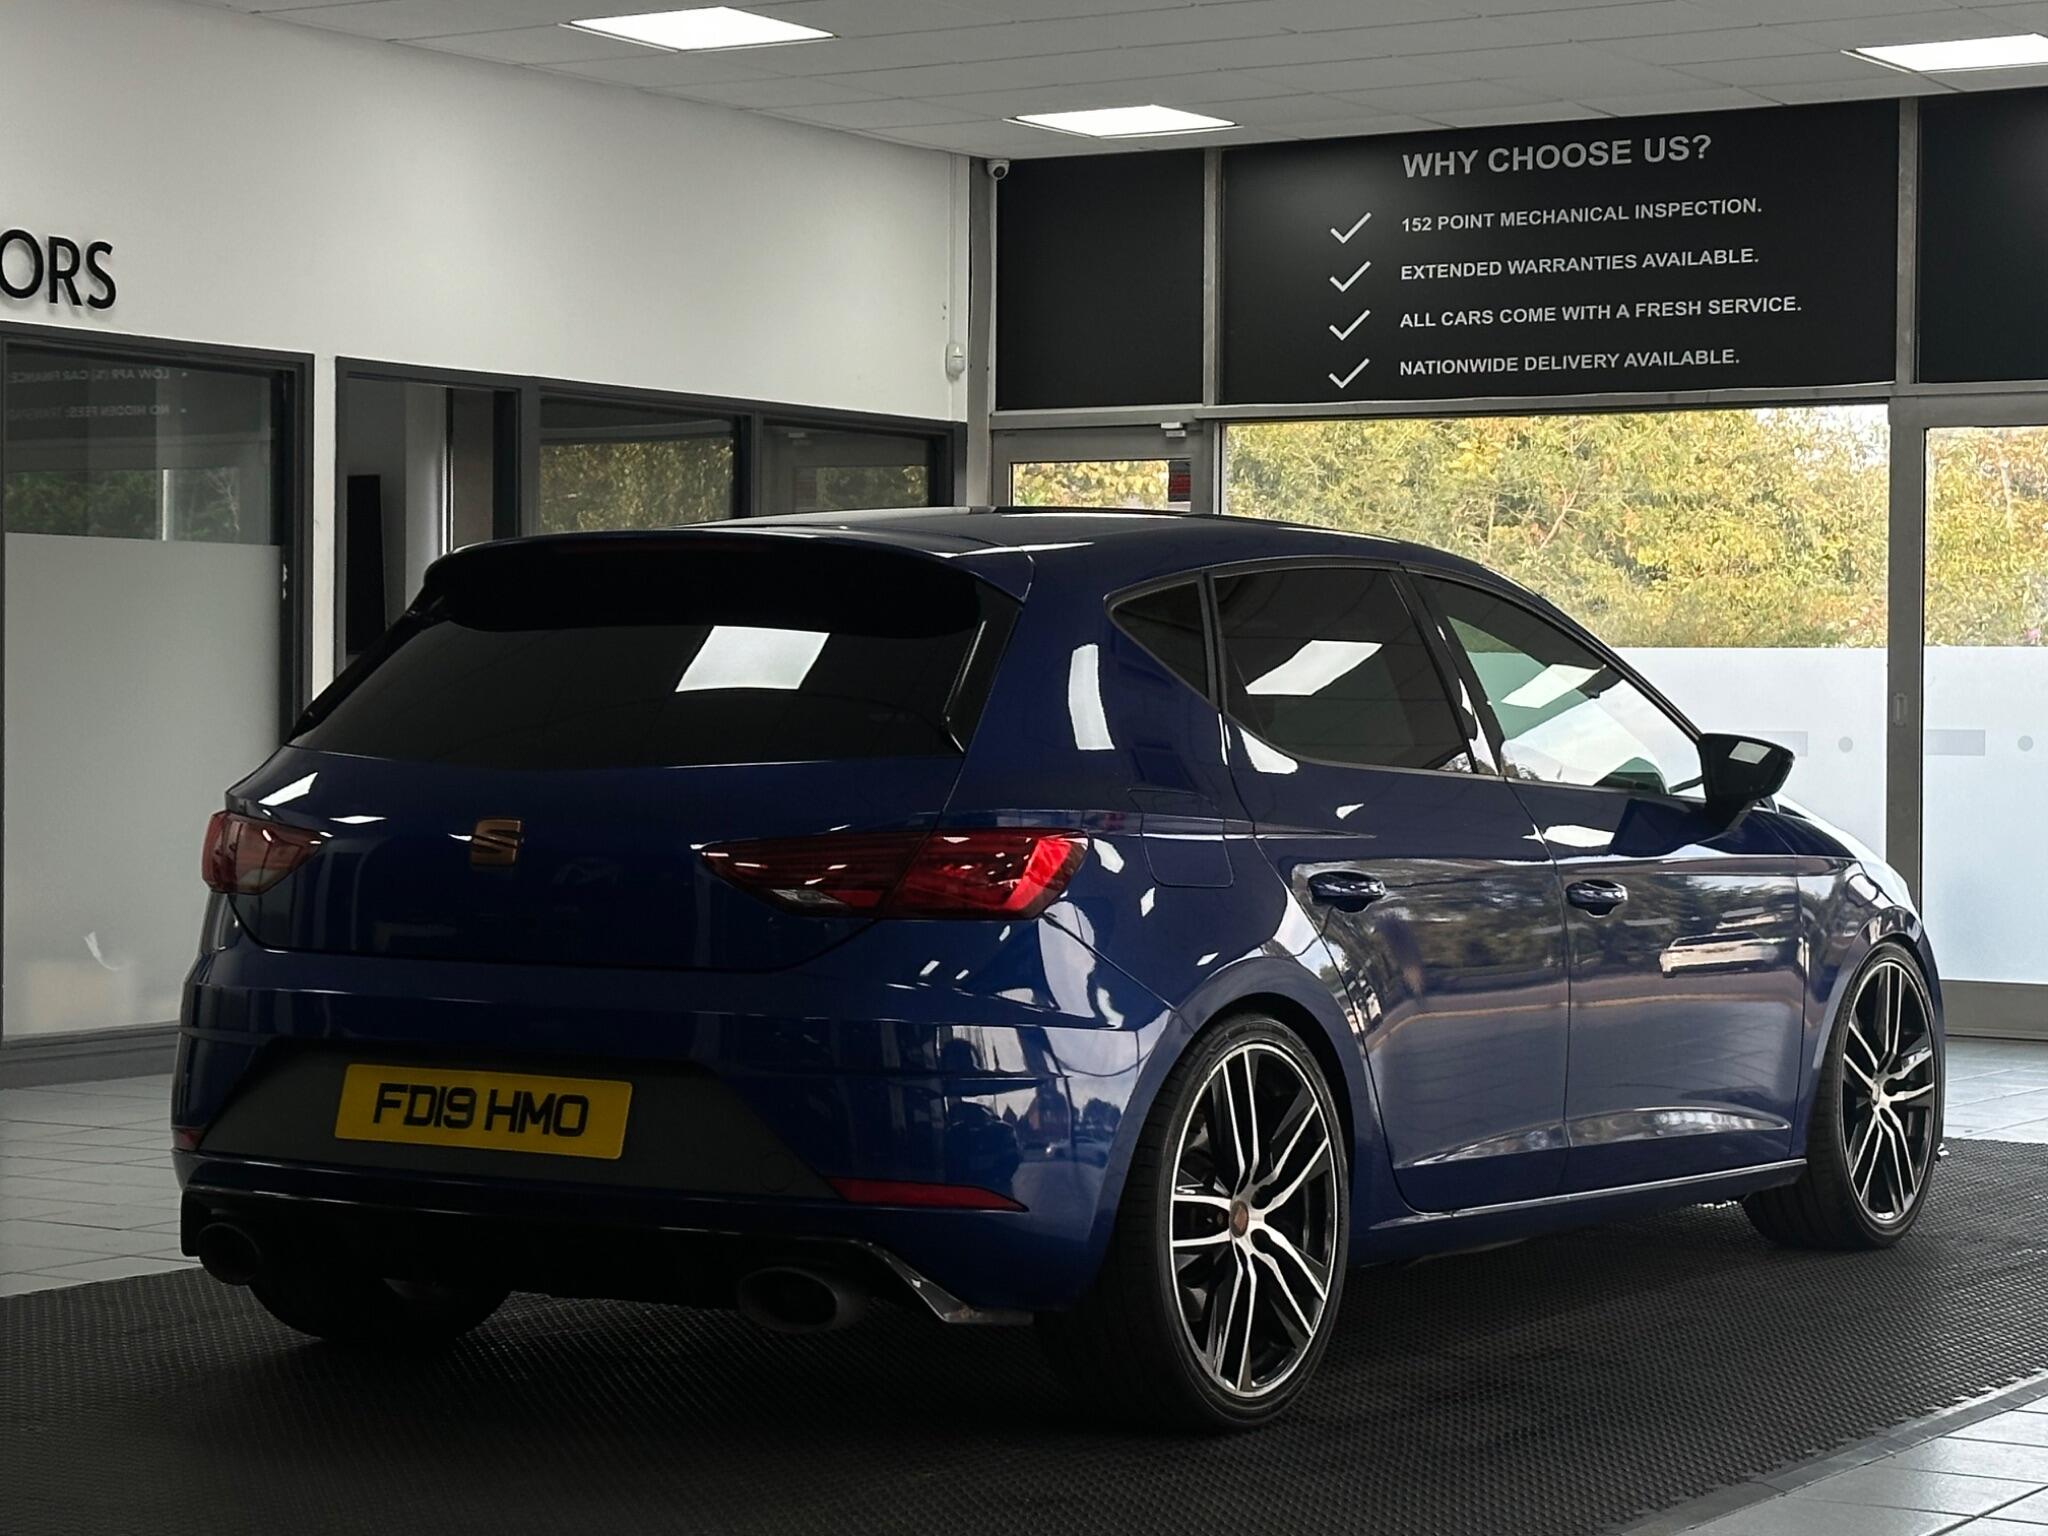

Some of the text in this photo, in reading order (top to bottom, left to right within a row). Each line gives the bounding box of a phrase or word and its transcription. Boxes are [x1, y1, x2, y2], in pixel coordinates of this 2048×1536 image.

[1402, 134, 1712, 179] WHY CHOOSE US?
[1401, 197, 1762, 233] 152 POINT MECHANICAL INSPECTION.
[1400, 248, 1759, 281] EXTENDED WARRANTIES AVAILABLE.
[1399, 295, 1802, 329] ALL CARS COME WITH A FRESH SERVICE.
[1399, 348, 1740, 376] NATIONWIDE DELIVERY AVAILABLE.
[372, 1082, 590, 1138] FD19 HMO
